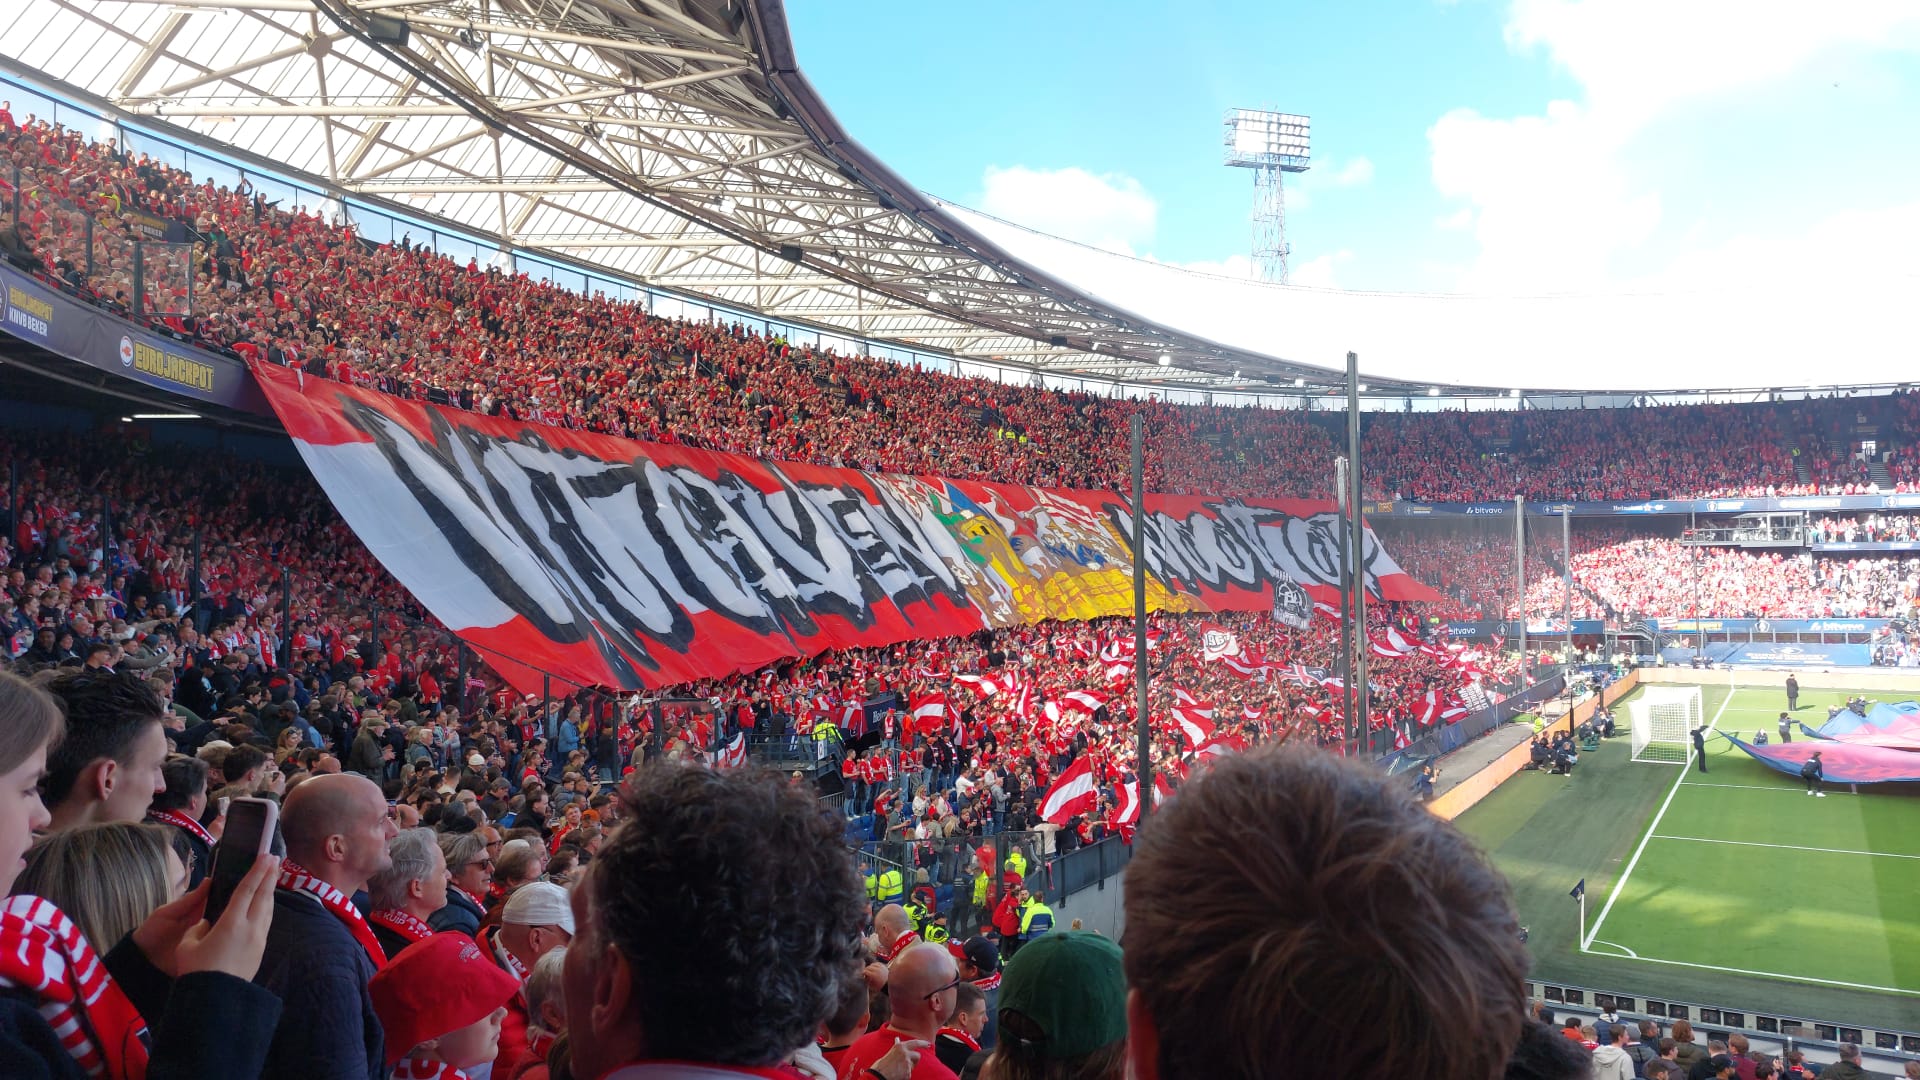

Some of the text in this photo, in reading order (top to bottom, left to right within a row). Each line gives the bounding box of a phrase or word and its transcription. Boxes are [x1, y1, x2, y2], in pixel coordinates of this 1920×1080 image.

[9, 305, 48, 337] KNVB BEKER
[134, 340, 215, 393] EUROJACKPOT
